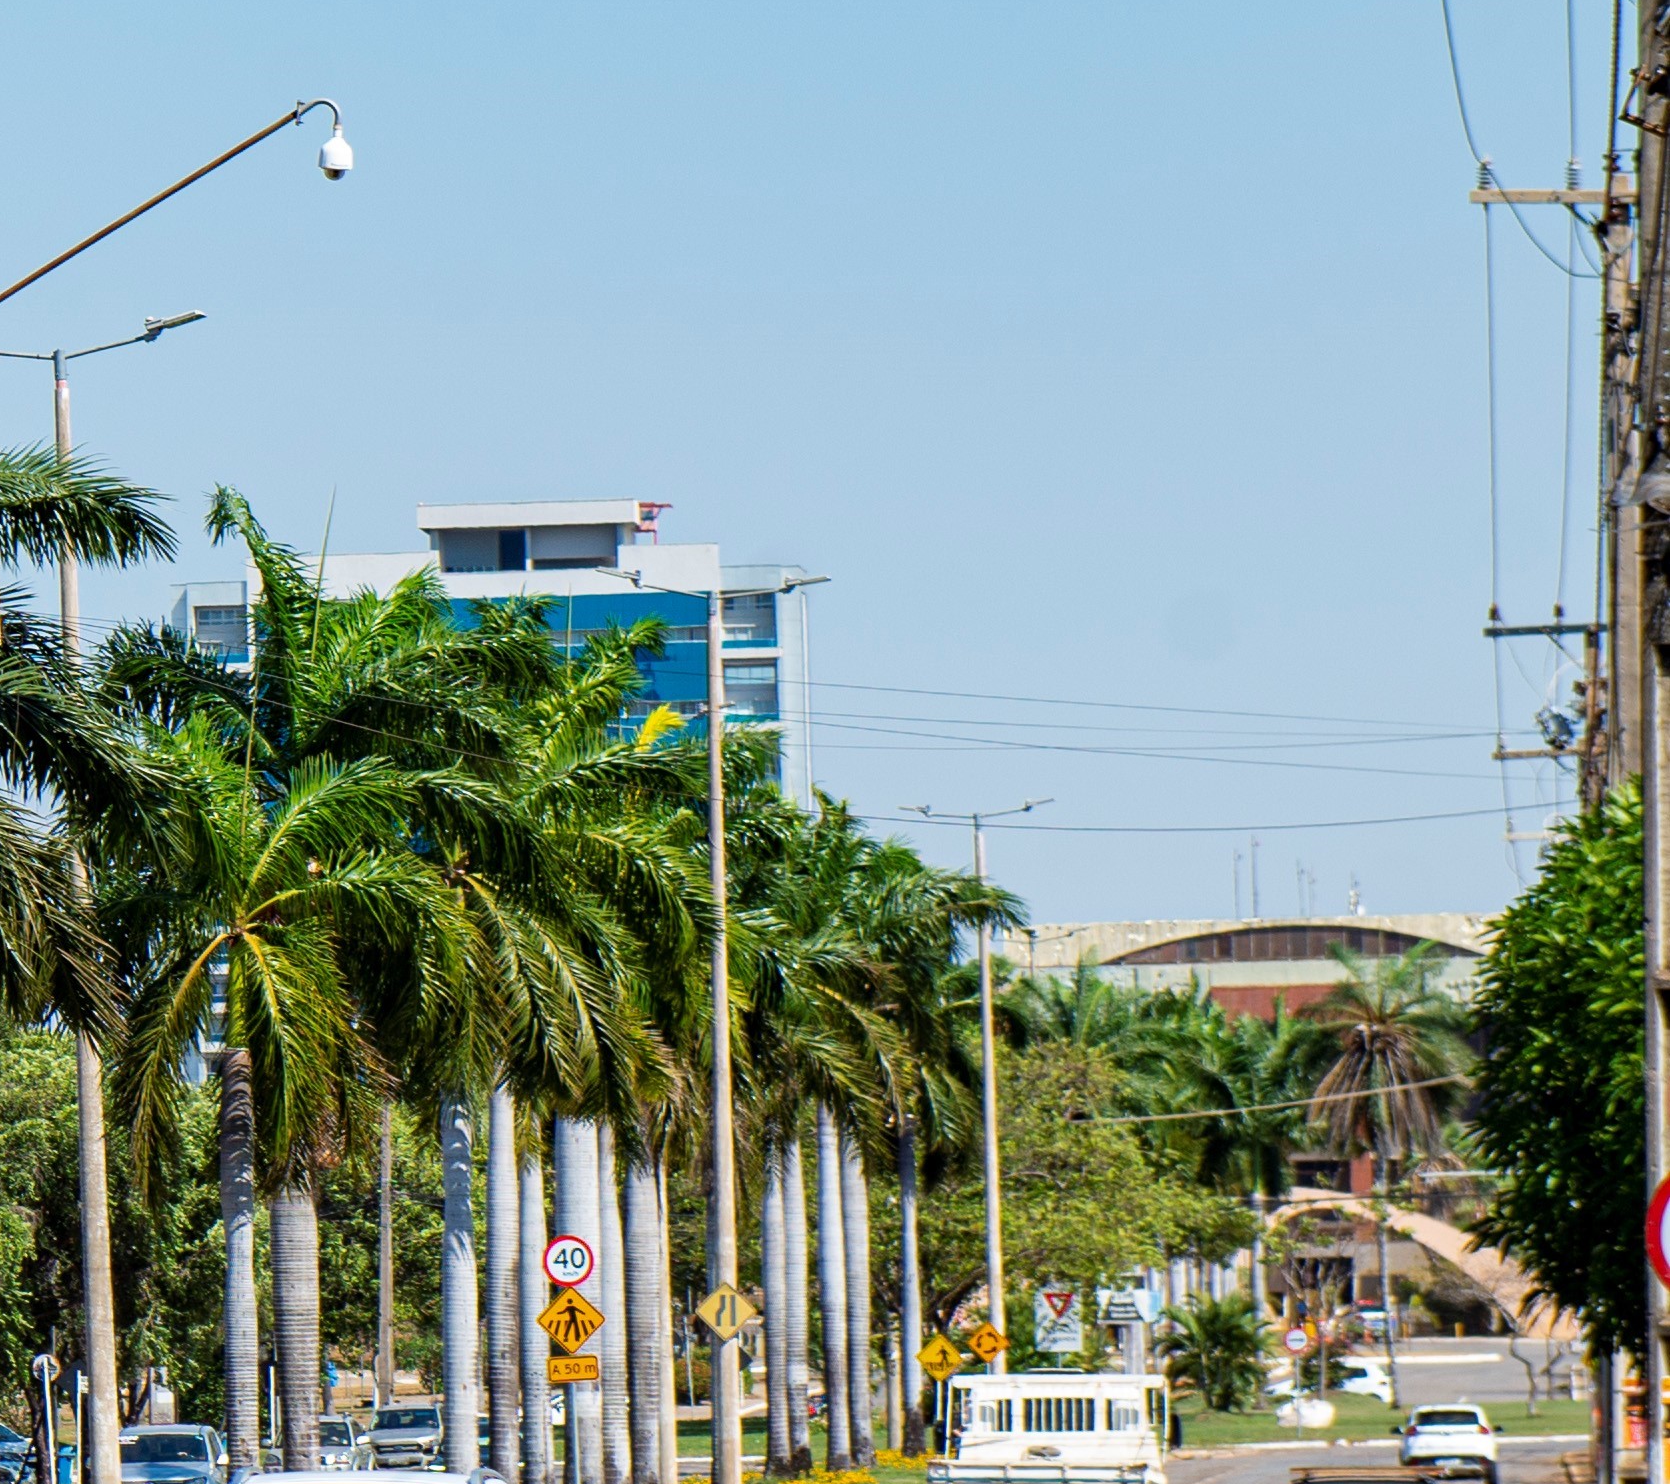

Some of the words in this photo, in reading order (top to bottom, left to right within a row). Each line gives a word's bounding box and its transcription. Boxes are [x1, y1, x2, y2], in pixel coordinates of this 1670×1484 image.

[553, 1247, 585, 1269] 40
[553, 1364, 560, 1375] A
[564, 1363, 580, 1374] 50
[584, 1364, 596, 1374] m
